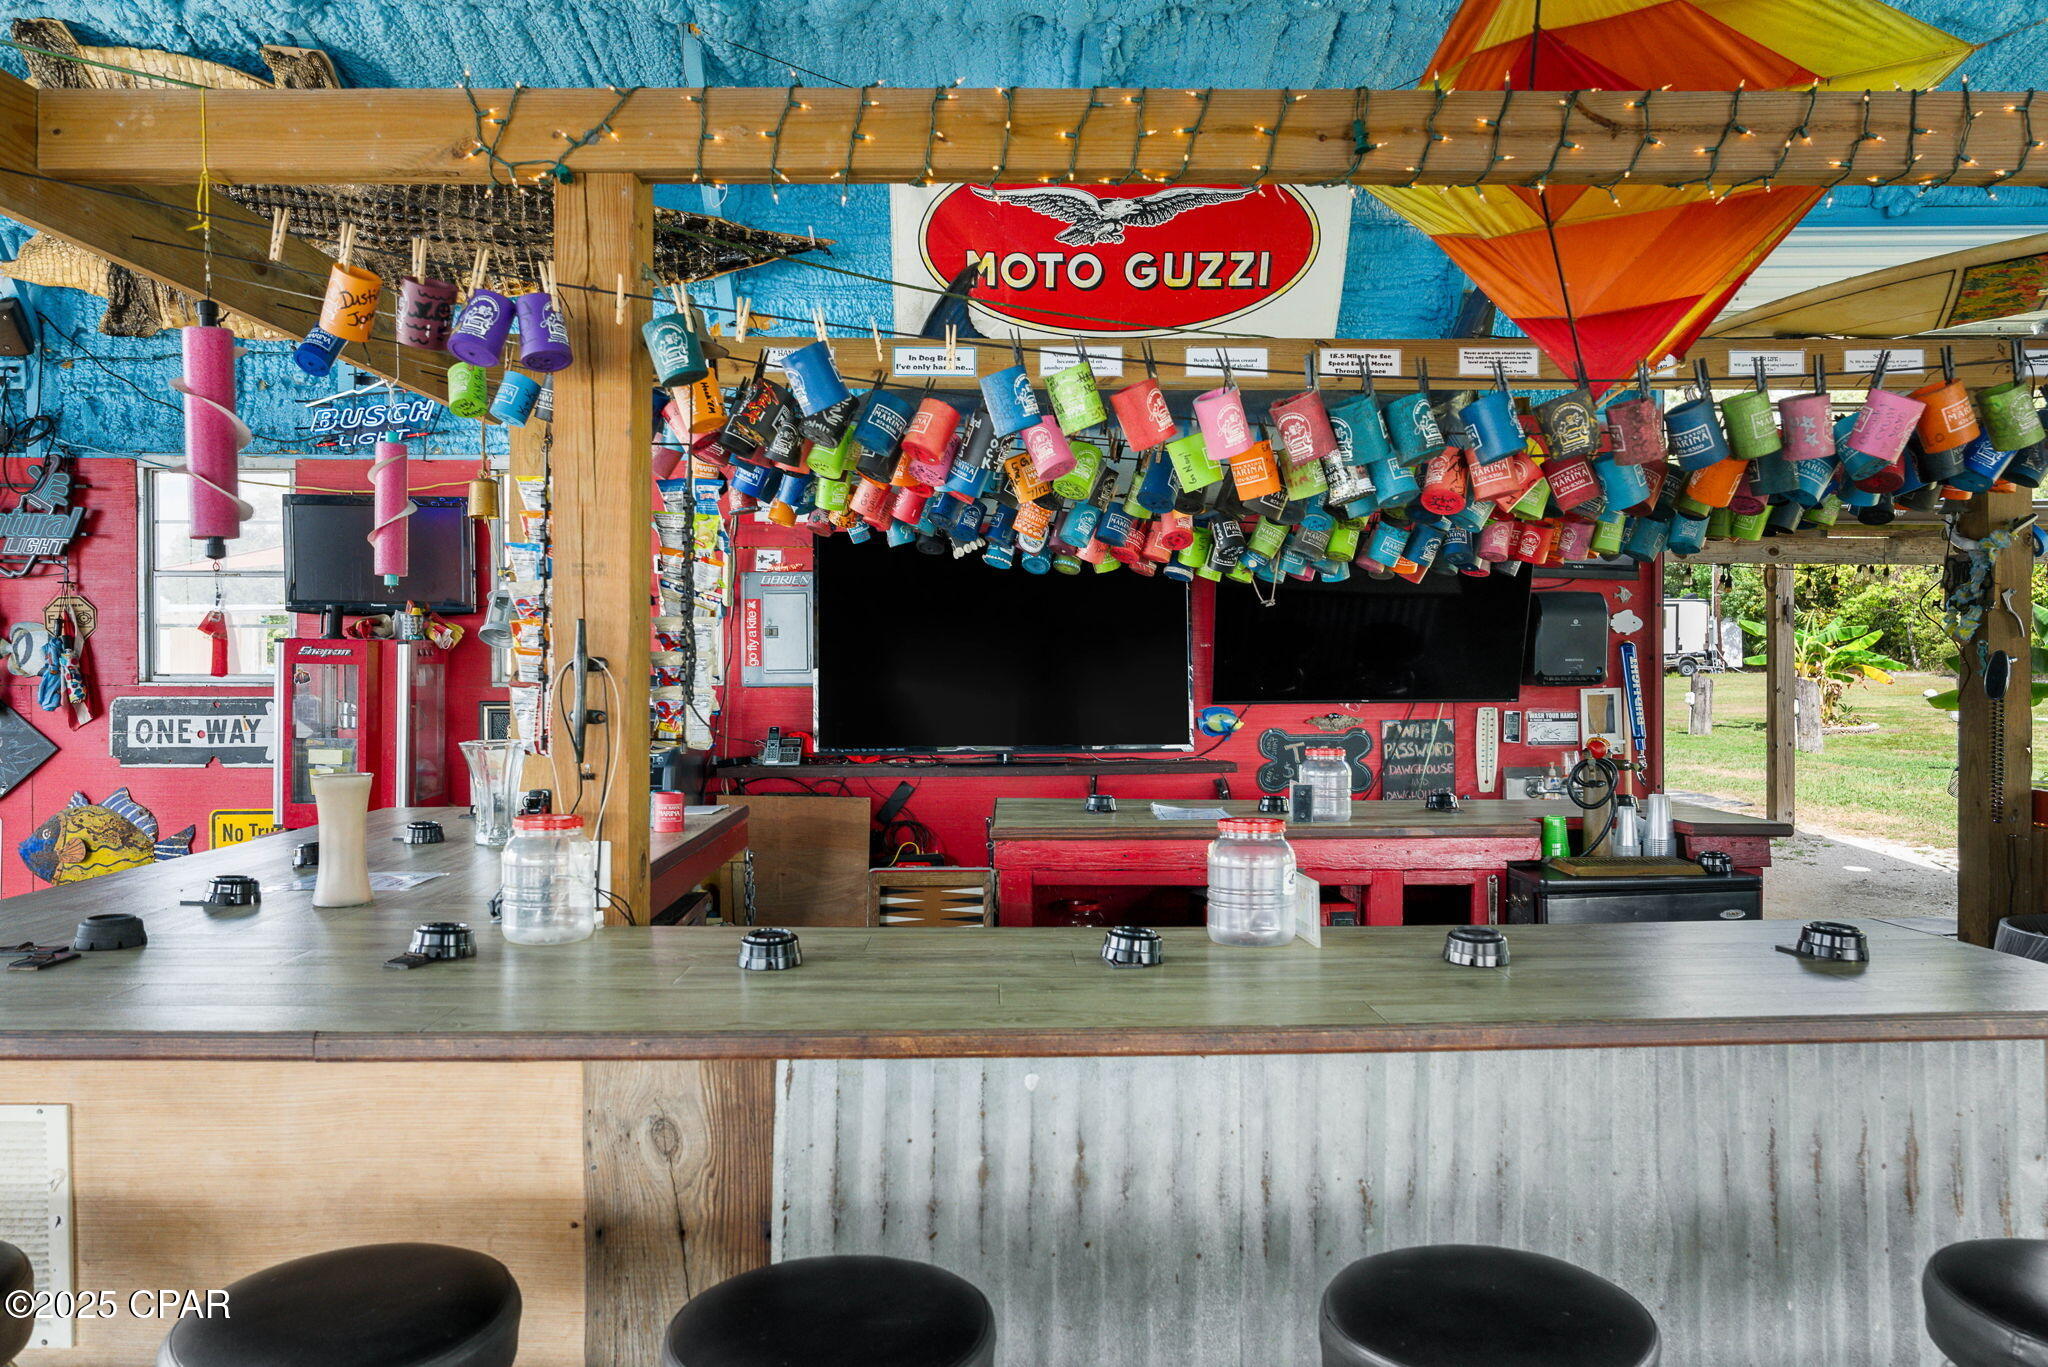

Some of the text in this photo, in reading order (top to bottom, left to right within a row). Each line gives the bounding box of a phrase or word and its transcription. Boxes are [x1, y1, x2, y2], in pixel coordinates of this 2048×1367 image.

[966, 249, 1272, 291] MOTO GUZZI
[912, 363, 931, 371] only
[310, 400, 435, 432] BUSCH
[873, 410, 904, 432] MARINA
[340, 428, 410, 447] LIGHT
[1471, 462, 1508, 477] MARINA
[1552, 470, 1589, 489] MARINA
[3, 537, 69, 555] LIGHT
[746, 610, 759, 667] go fly a kite
[135, 719, 261, 746] ONE WAY
[1384, 741, 1454, 760] PASSWORD
[1389, 762, 1454, 776] DAWGHOUSE
[222, 823, 244, 842] No
